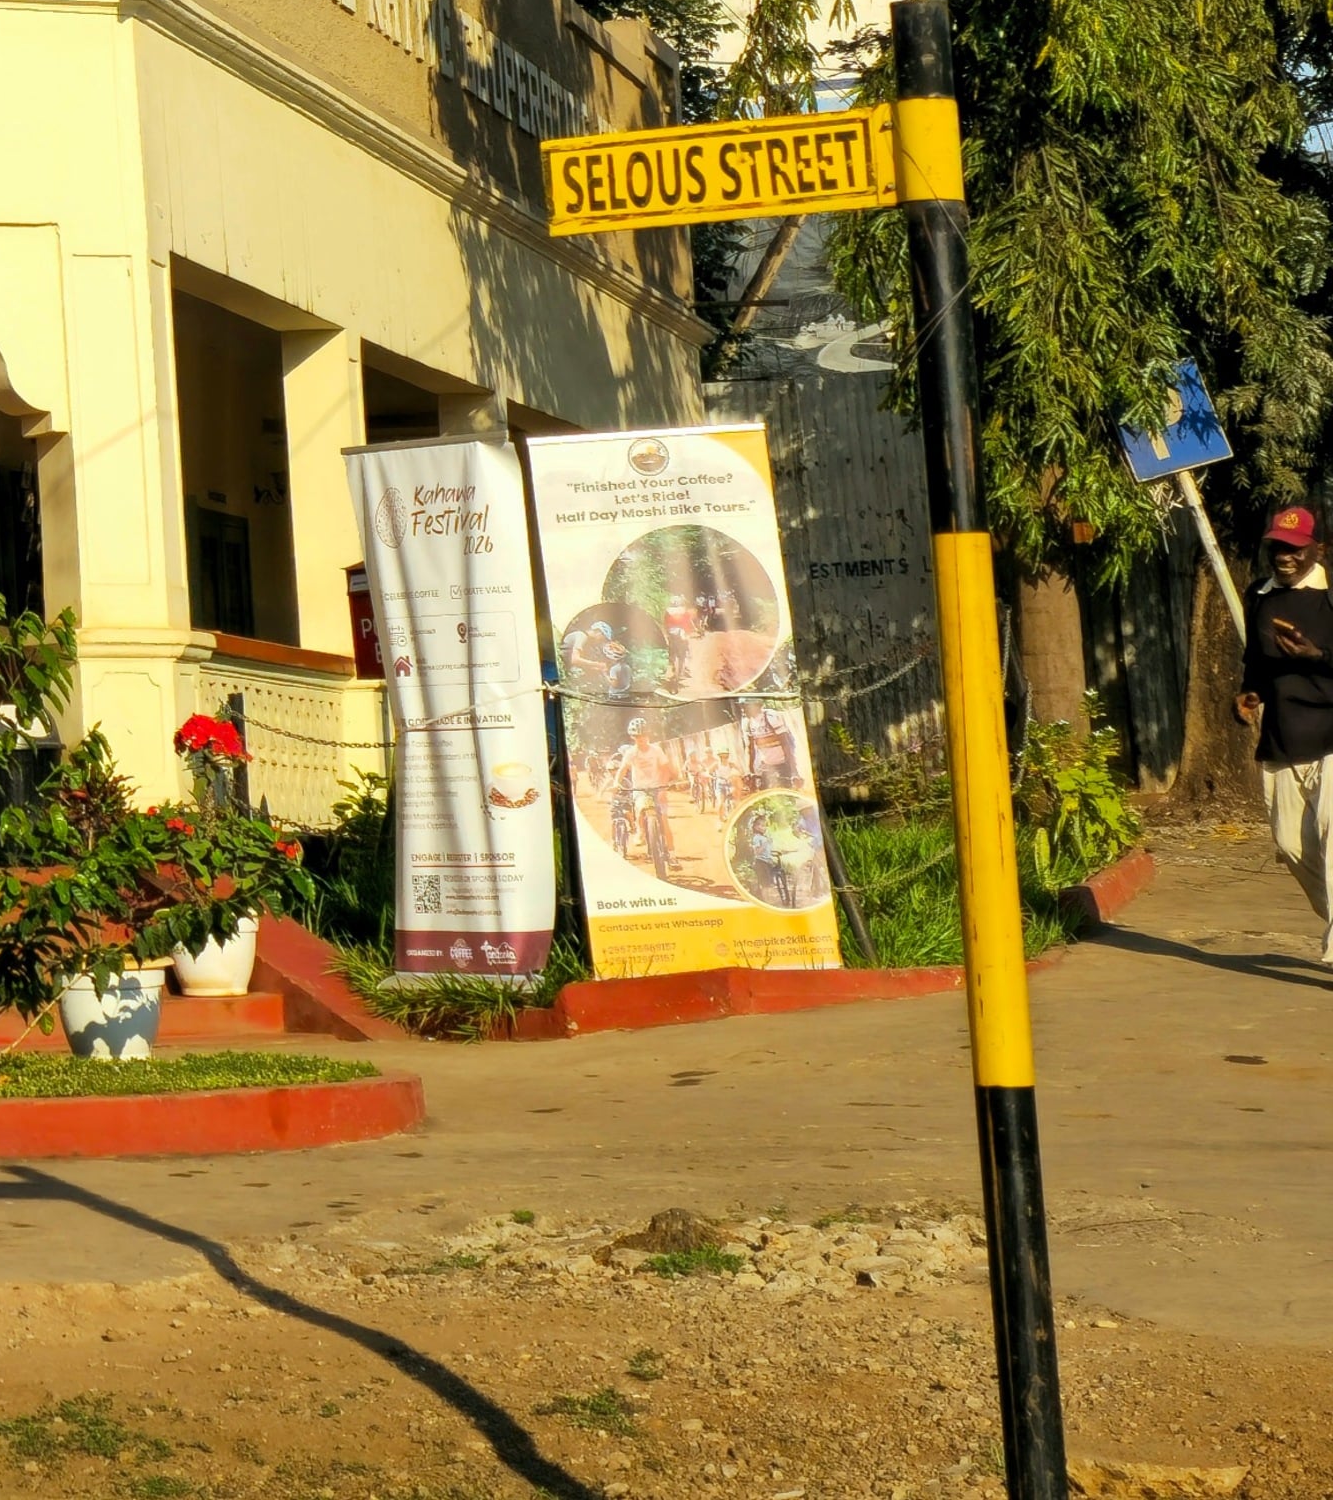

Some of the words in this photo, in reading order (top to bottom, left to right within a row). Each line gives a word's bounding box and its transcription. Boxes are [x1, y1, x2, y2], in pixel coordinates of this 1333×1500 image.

[563, 145, 707, 214] SELOUS
[719, 130, 859, 201] STREET
[639, 477, 675, 489] Your
[677, 472, 733, 486] Coffee?
[413, 483, 476, 507] Kahawa
[652, 489, 690, 502] Ride!
[411, 504, 489, 537] Festival
[556, 510, 585, 523] Half
[589, 509, 618, 523] Day
[622, 504, 666, 518] Moshi
[669, 502, 701, 516] Bike
[464, 535, 493, 556] 2026
[596, 899, 627, 911] Book
[629, 897, 656, 909] with
[659, 897, 677, 907] us:
[598, 923, 639, 933] Contact
